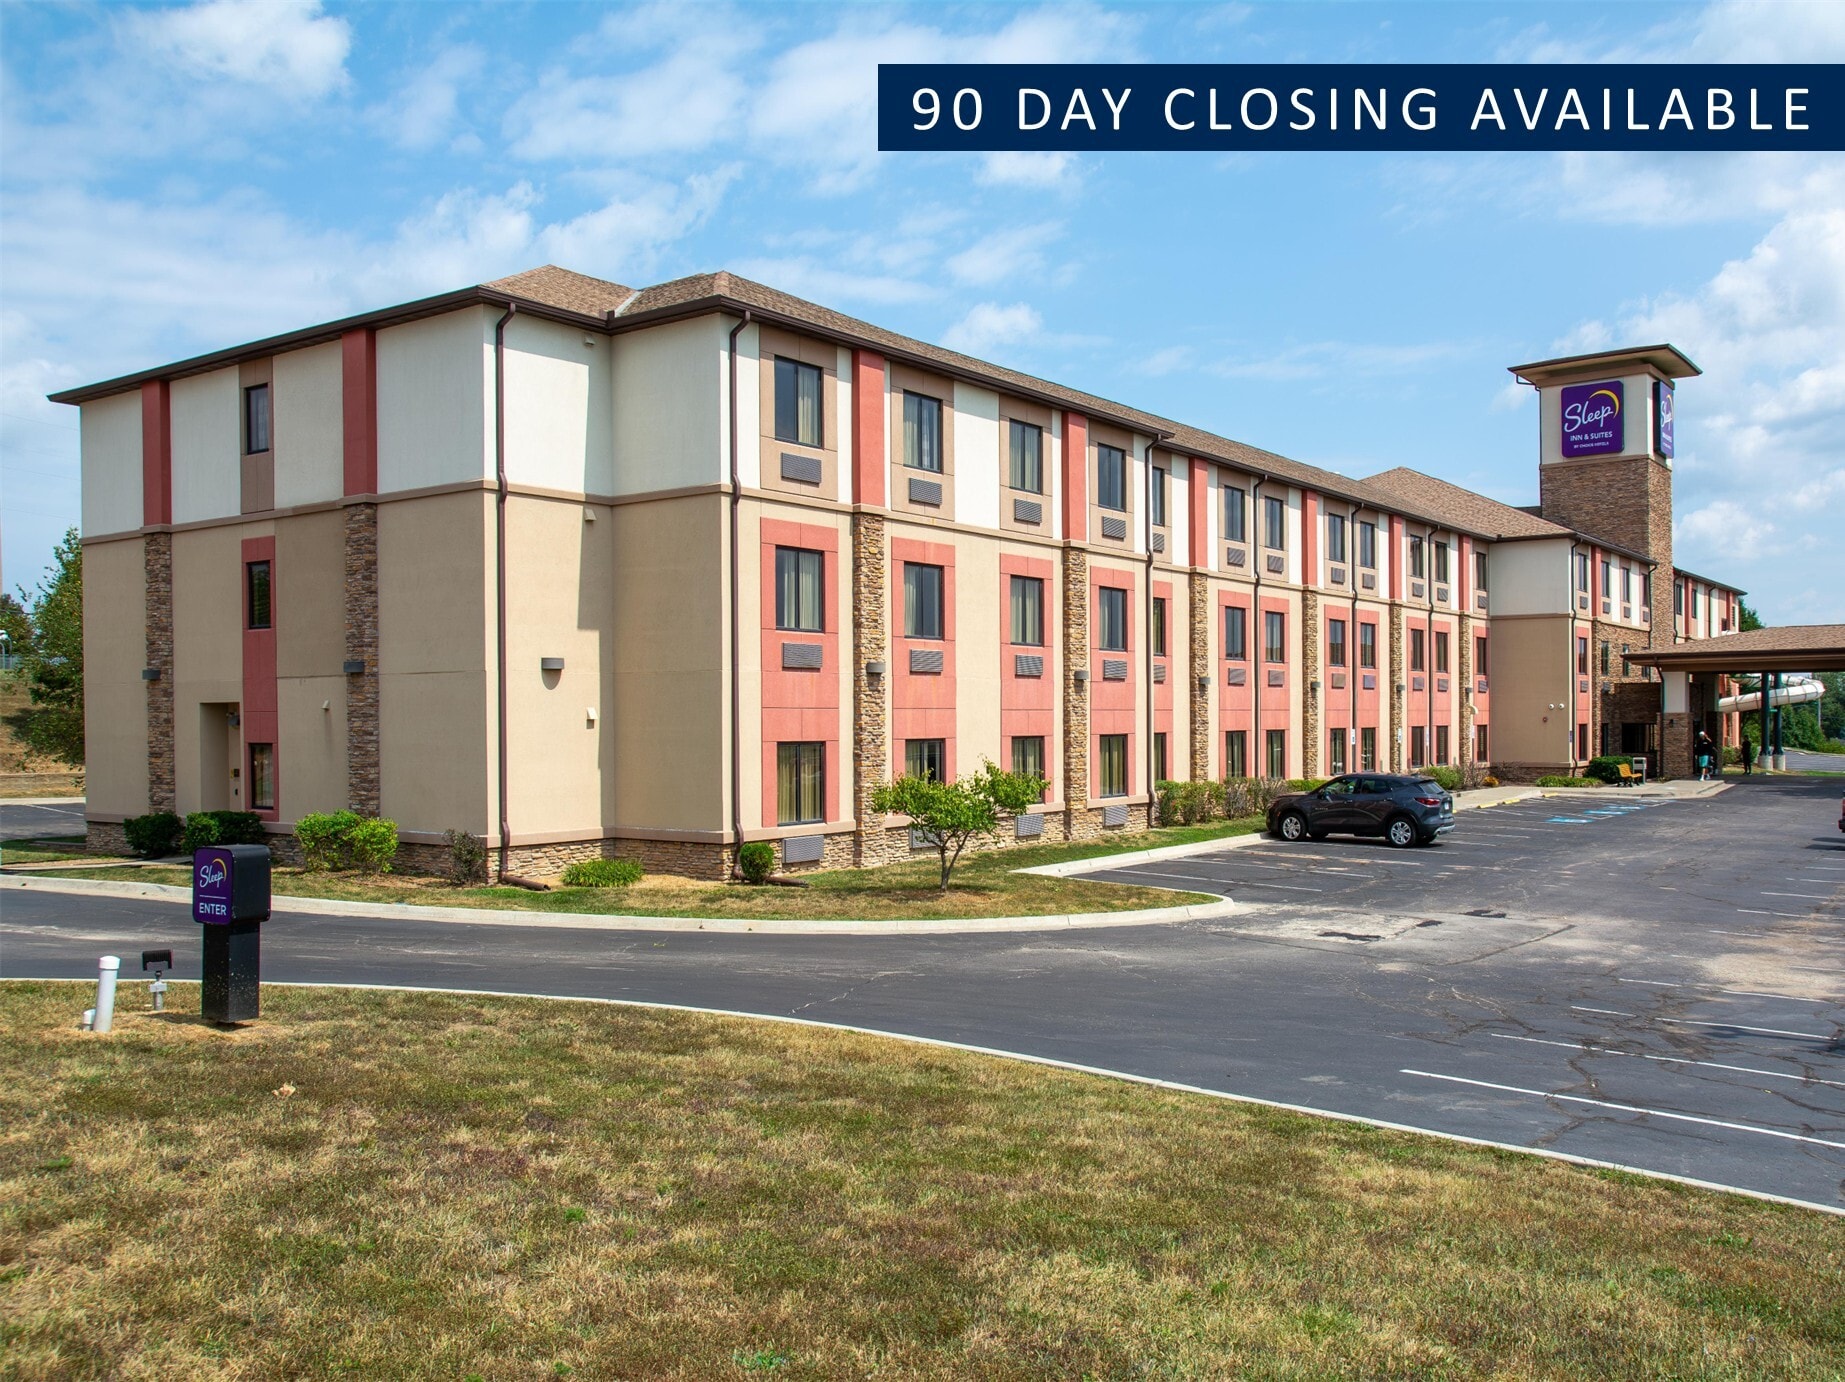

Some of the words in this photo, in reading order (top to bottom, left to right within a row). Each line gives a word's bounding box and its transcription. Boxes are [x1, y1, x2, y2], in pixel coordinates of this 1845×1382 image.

[1564, 400, 1614, 433] Sleep
[1570, 434, 1583, 442] INN
[1590, 431, 1613, 440] SUITES
[199, 864, 225, 888] Sleep
[199, 902, 227, 916] ENTER
